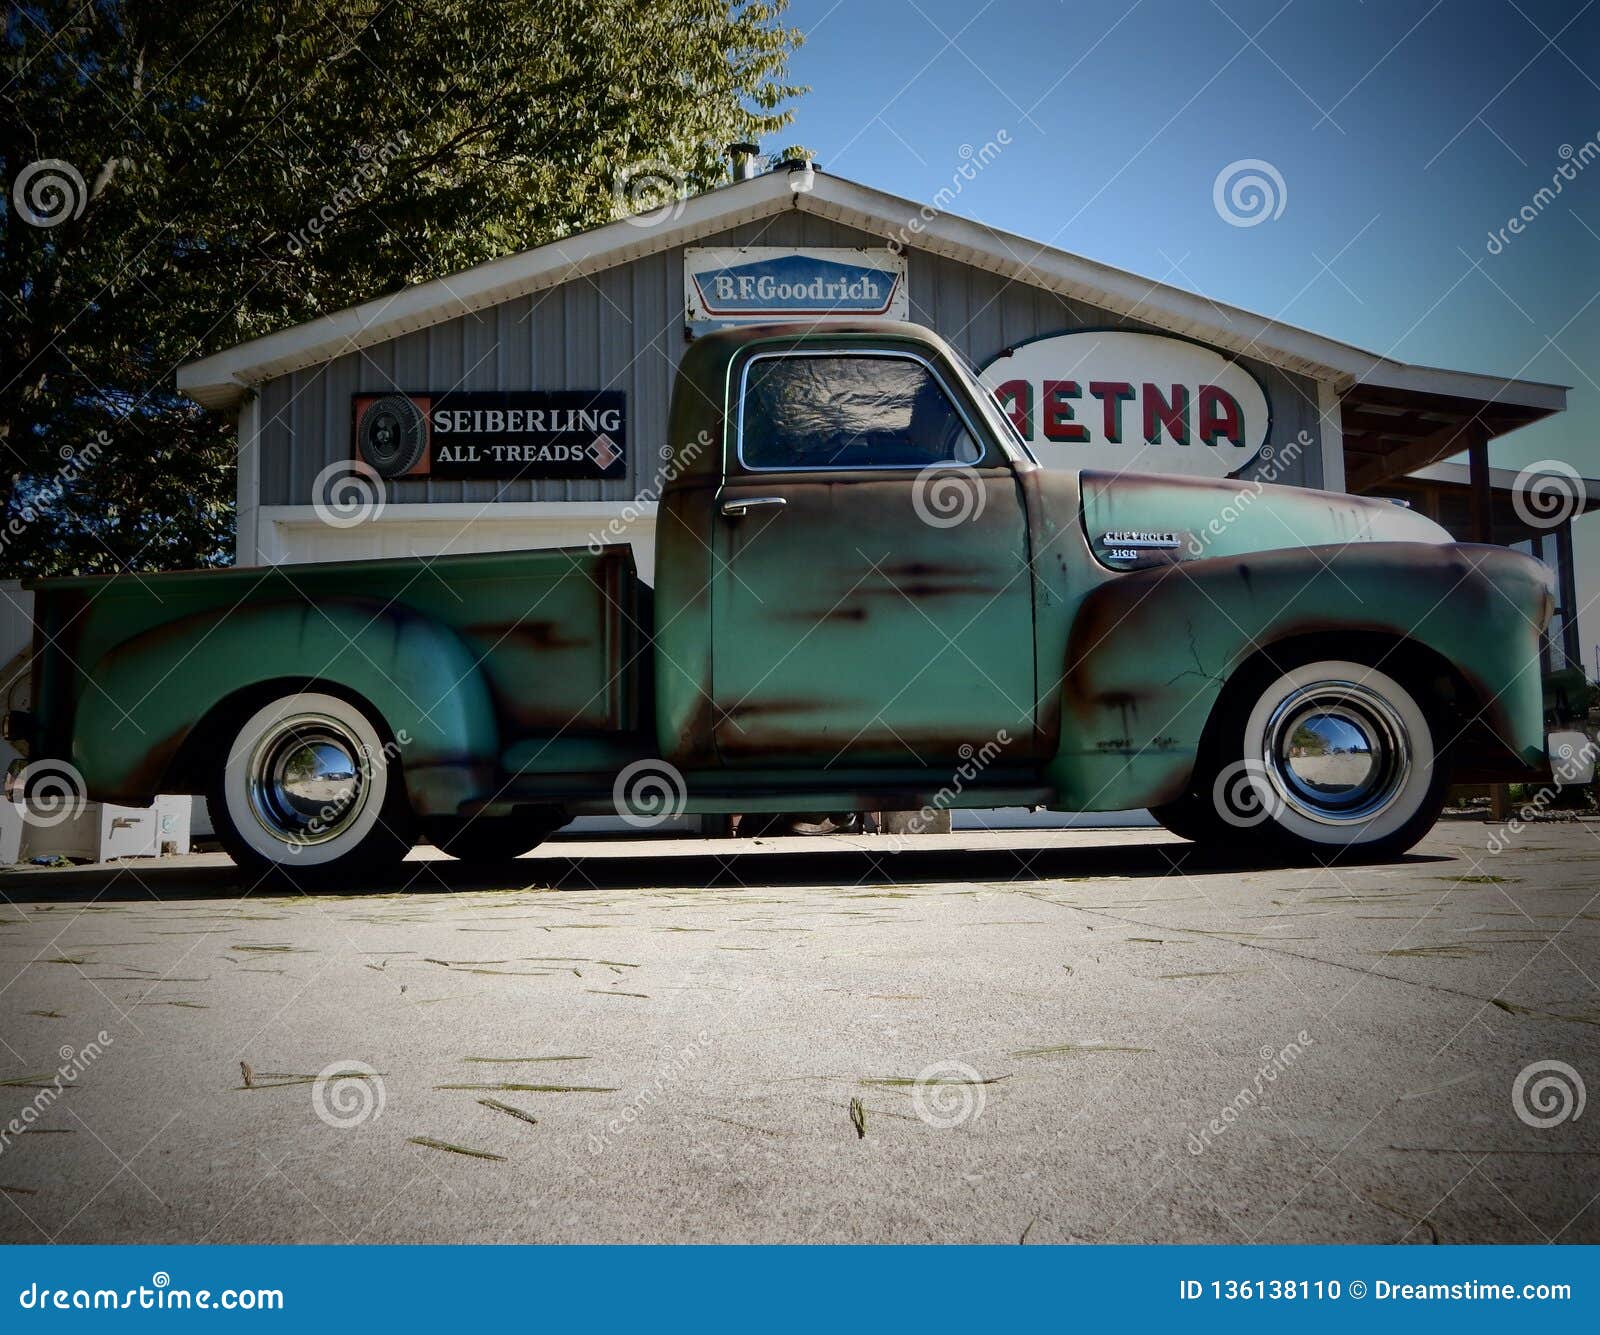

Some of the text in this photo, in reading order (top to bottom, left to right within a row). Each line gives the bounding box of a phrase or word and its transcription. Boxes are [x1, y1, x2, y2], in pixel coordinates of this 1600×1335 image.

[434, 409, 622, 434] SEIBERLING
[993, 379, 1246, 447] AETNA
[437, 444, 584, 462] ALL-TREADS
[1104, 531, 1179, 543] CHEVROLET
[1111, 548, 1137, 558] 3100
